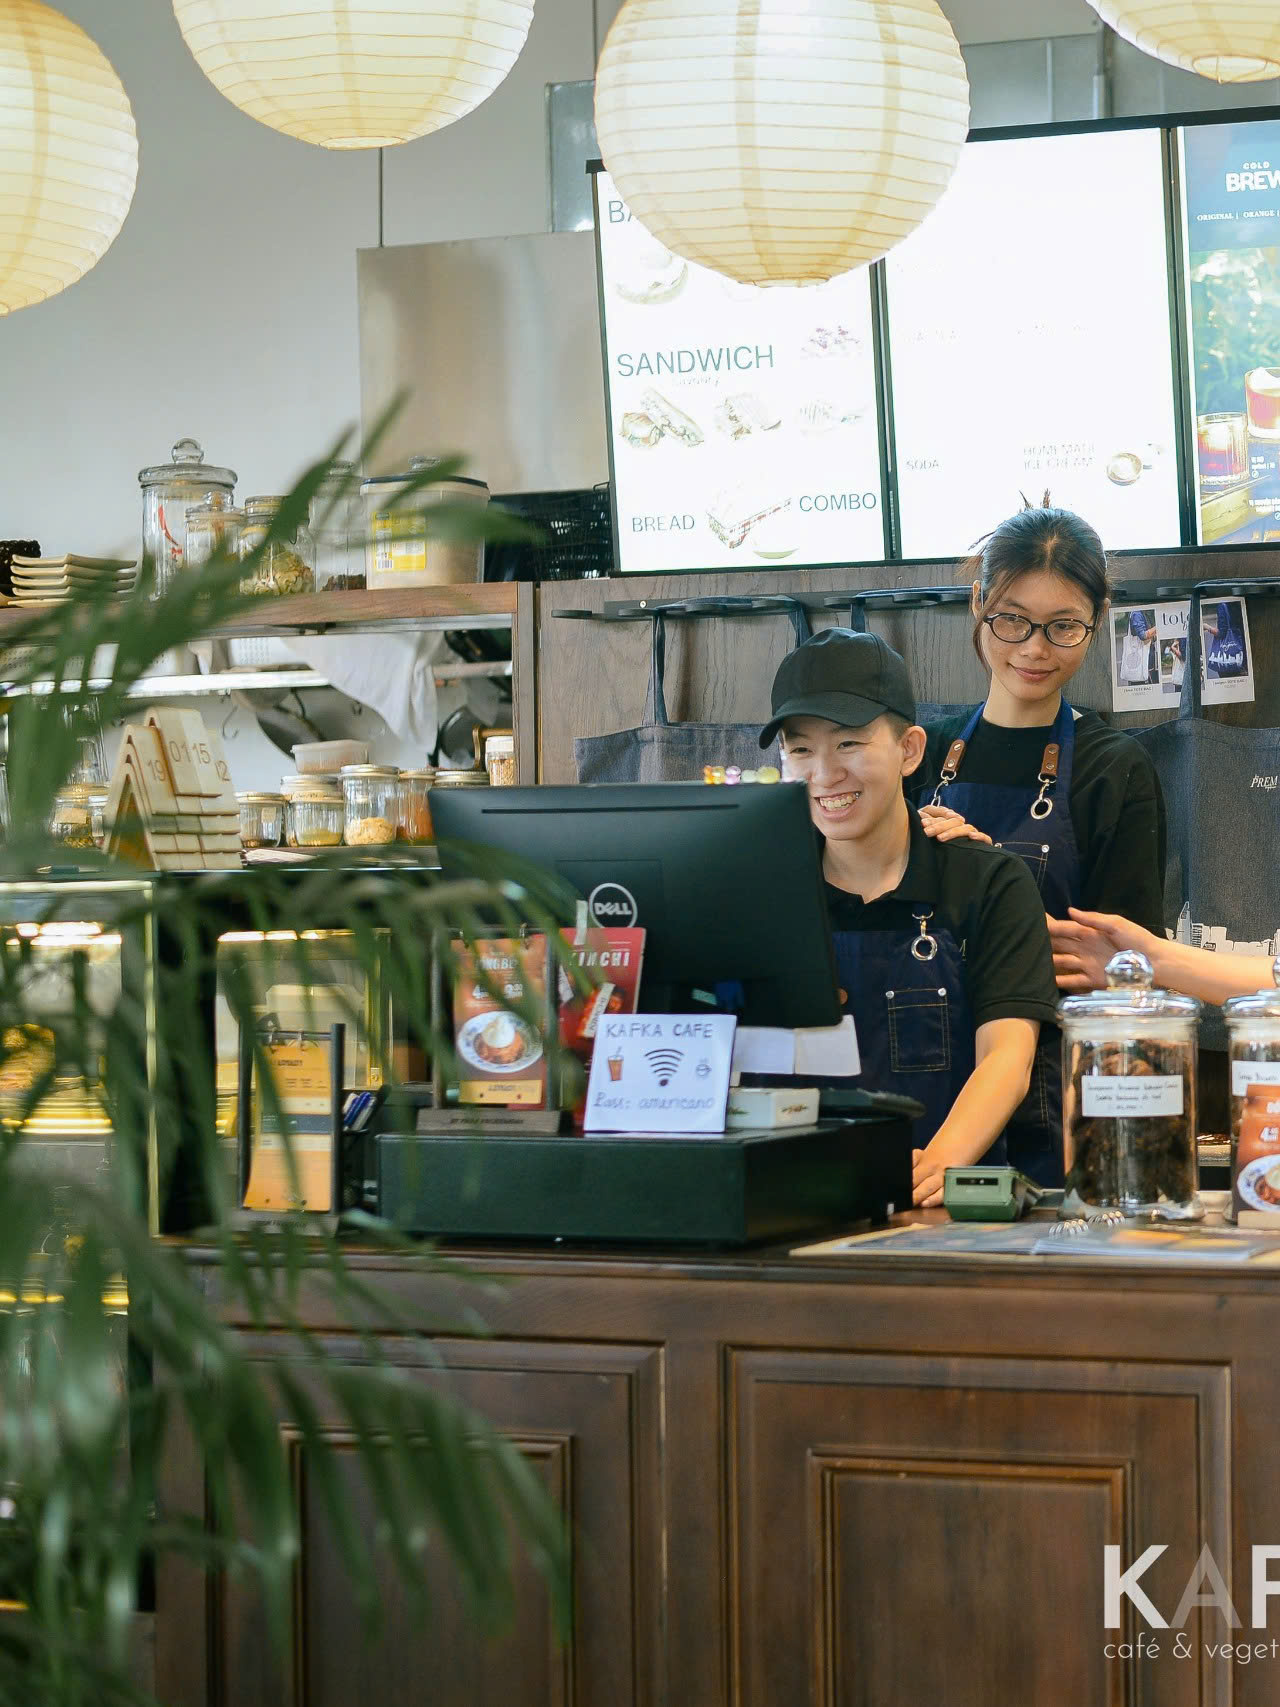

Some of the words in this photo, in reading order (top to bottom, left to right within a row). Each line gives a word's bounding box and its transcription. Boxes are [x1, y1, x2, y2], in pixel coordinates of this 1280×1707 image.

[1242, 161, 1270, 170] COLD
[1196, 212, 1234, 221] ORIGINAL
[1243, 209, 1276, 219] ORANGE
[617, 344, 774, 377] SANDWICH
[799, 493, 877, 512] COMBO
[632, 515, 695, 533] BREAD
[594, 902, 633, 916] DELL
[606, 1022, 663, 1038] KAFKA
[638, 1098, 716, 1110] americano
